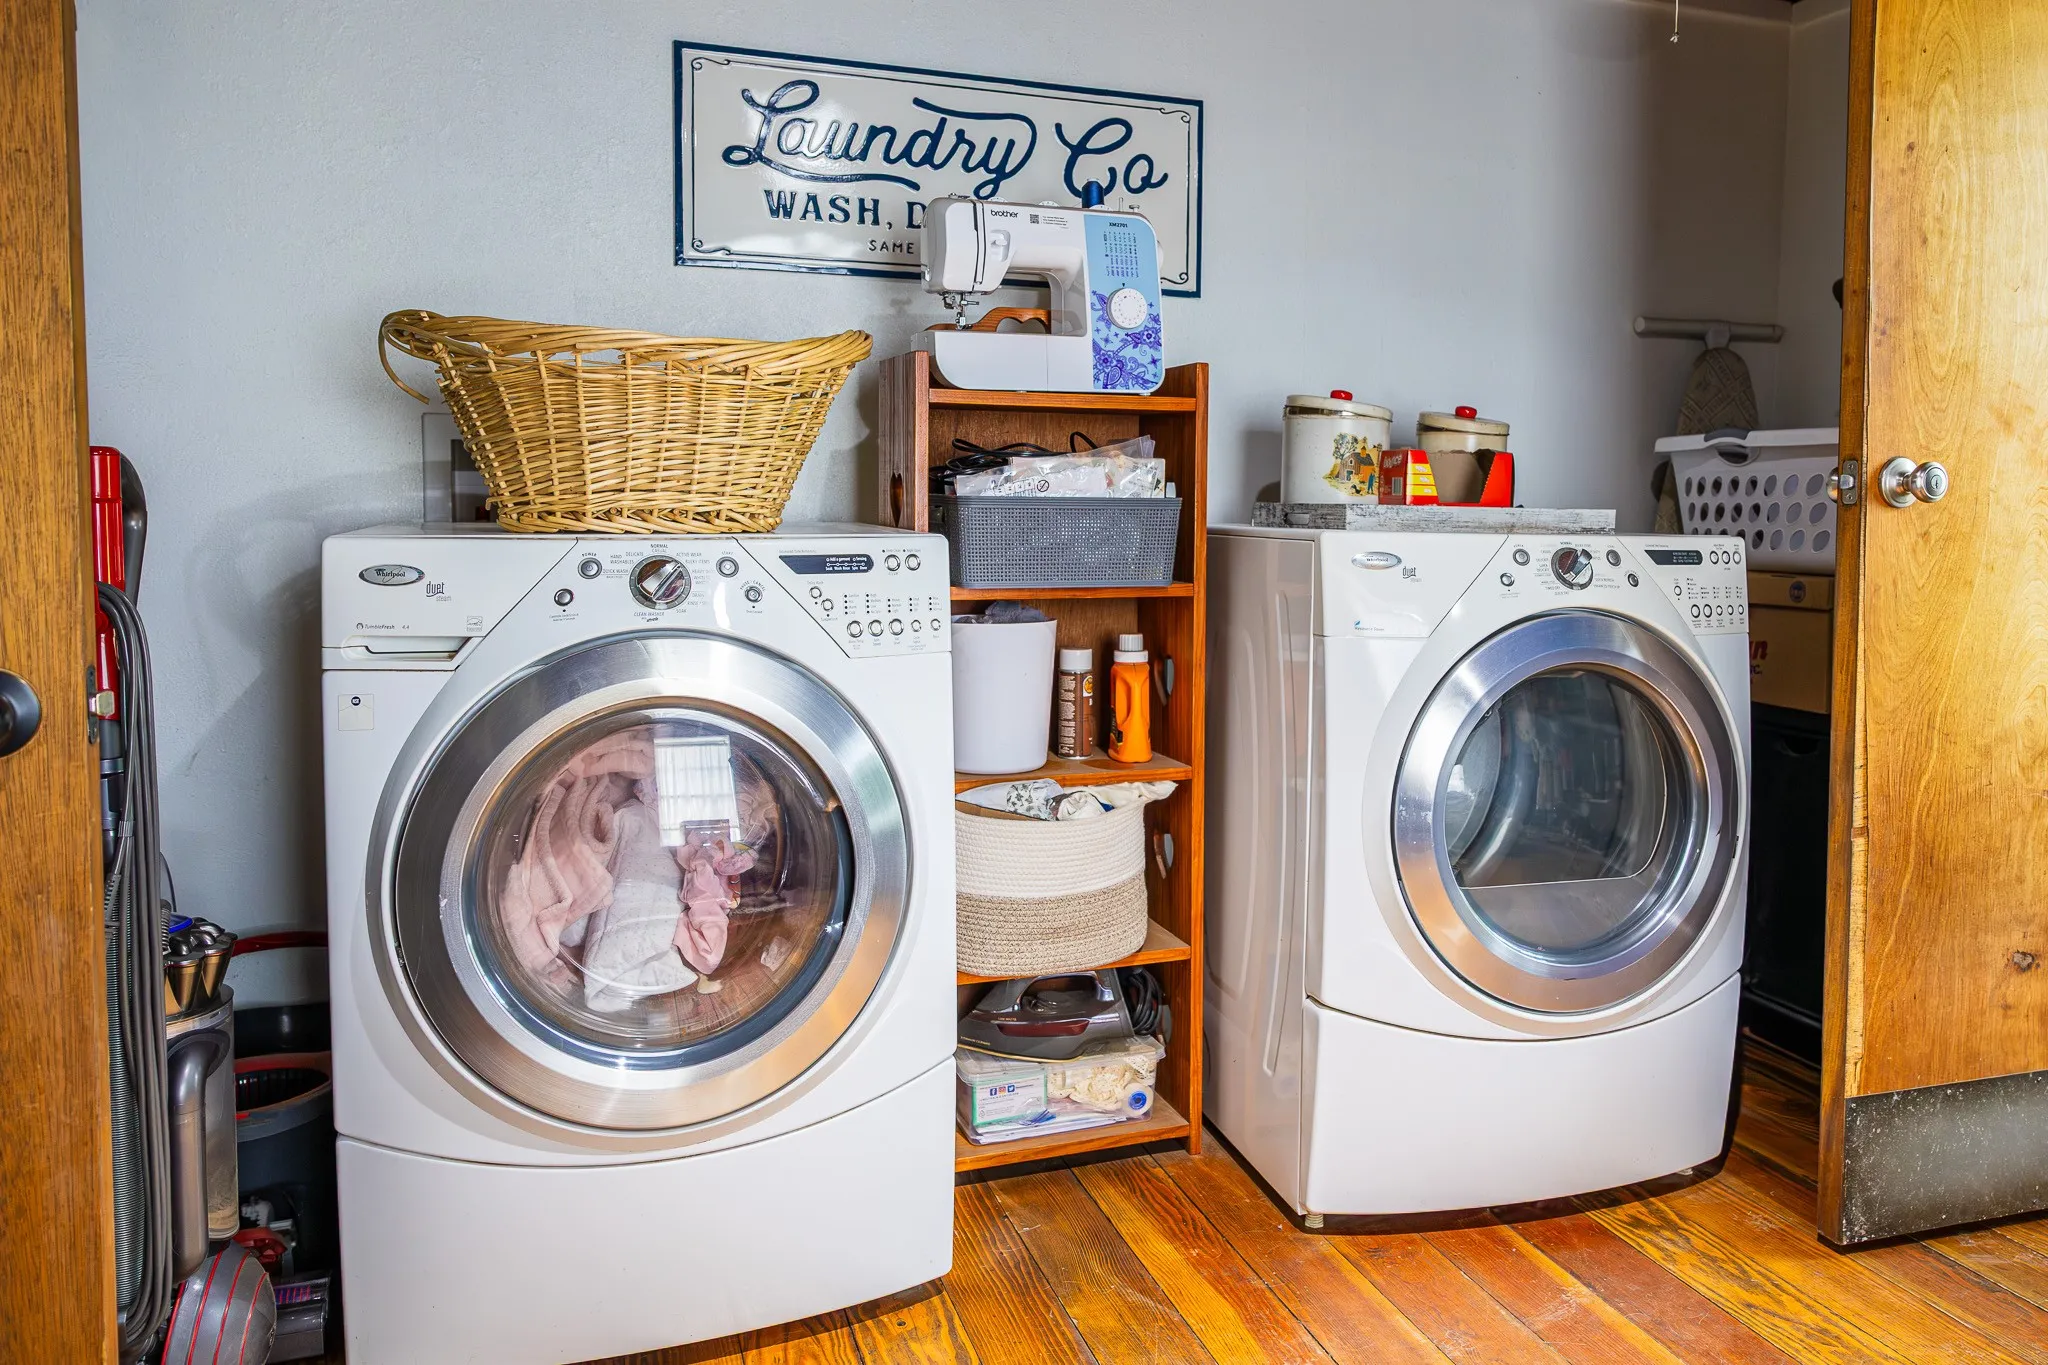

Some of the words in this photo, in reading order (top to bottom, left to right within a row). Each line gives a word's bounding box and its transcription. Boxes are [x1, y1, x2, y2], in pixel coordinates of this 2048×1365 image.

[722, 80, 1037, 200] Laundry
[1055, 117, 1168, 198] Co
[764, 189, 894, 230] WASH,
[990, 209, 1018, 219] brother
[869, 240, 914, 254] SAME
[374, 569, 406, 578] Whirlpool
[426, 581, 444, 597] duet
